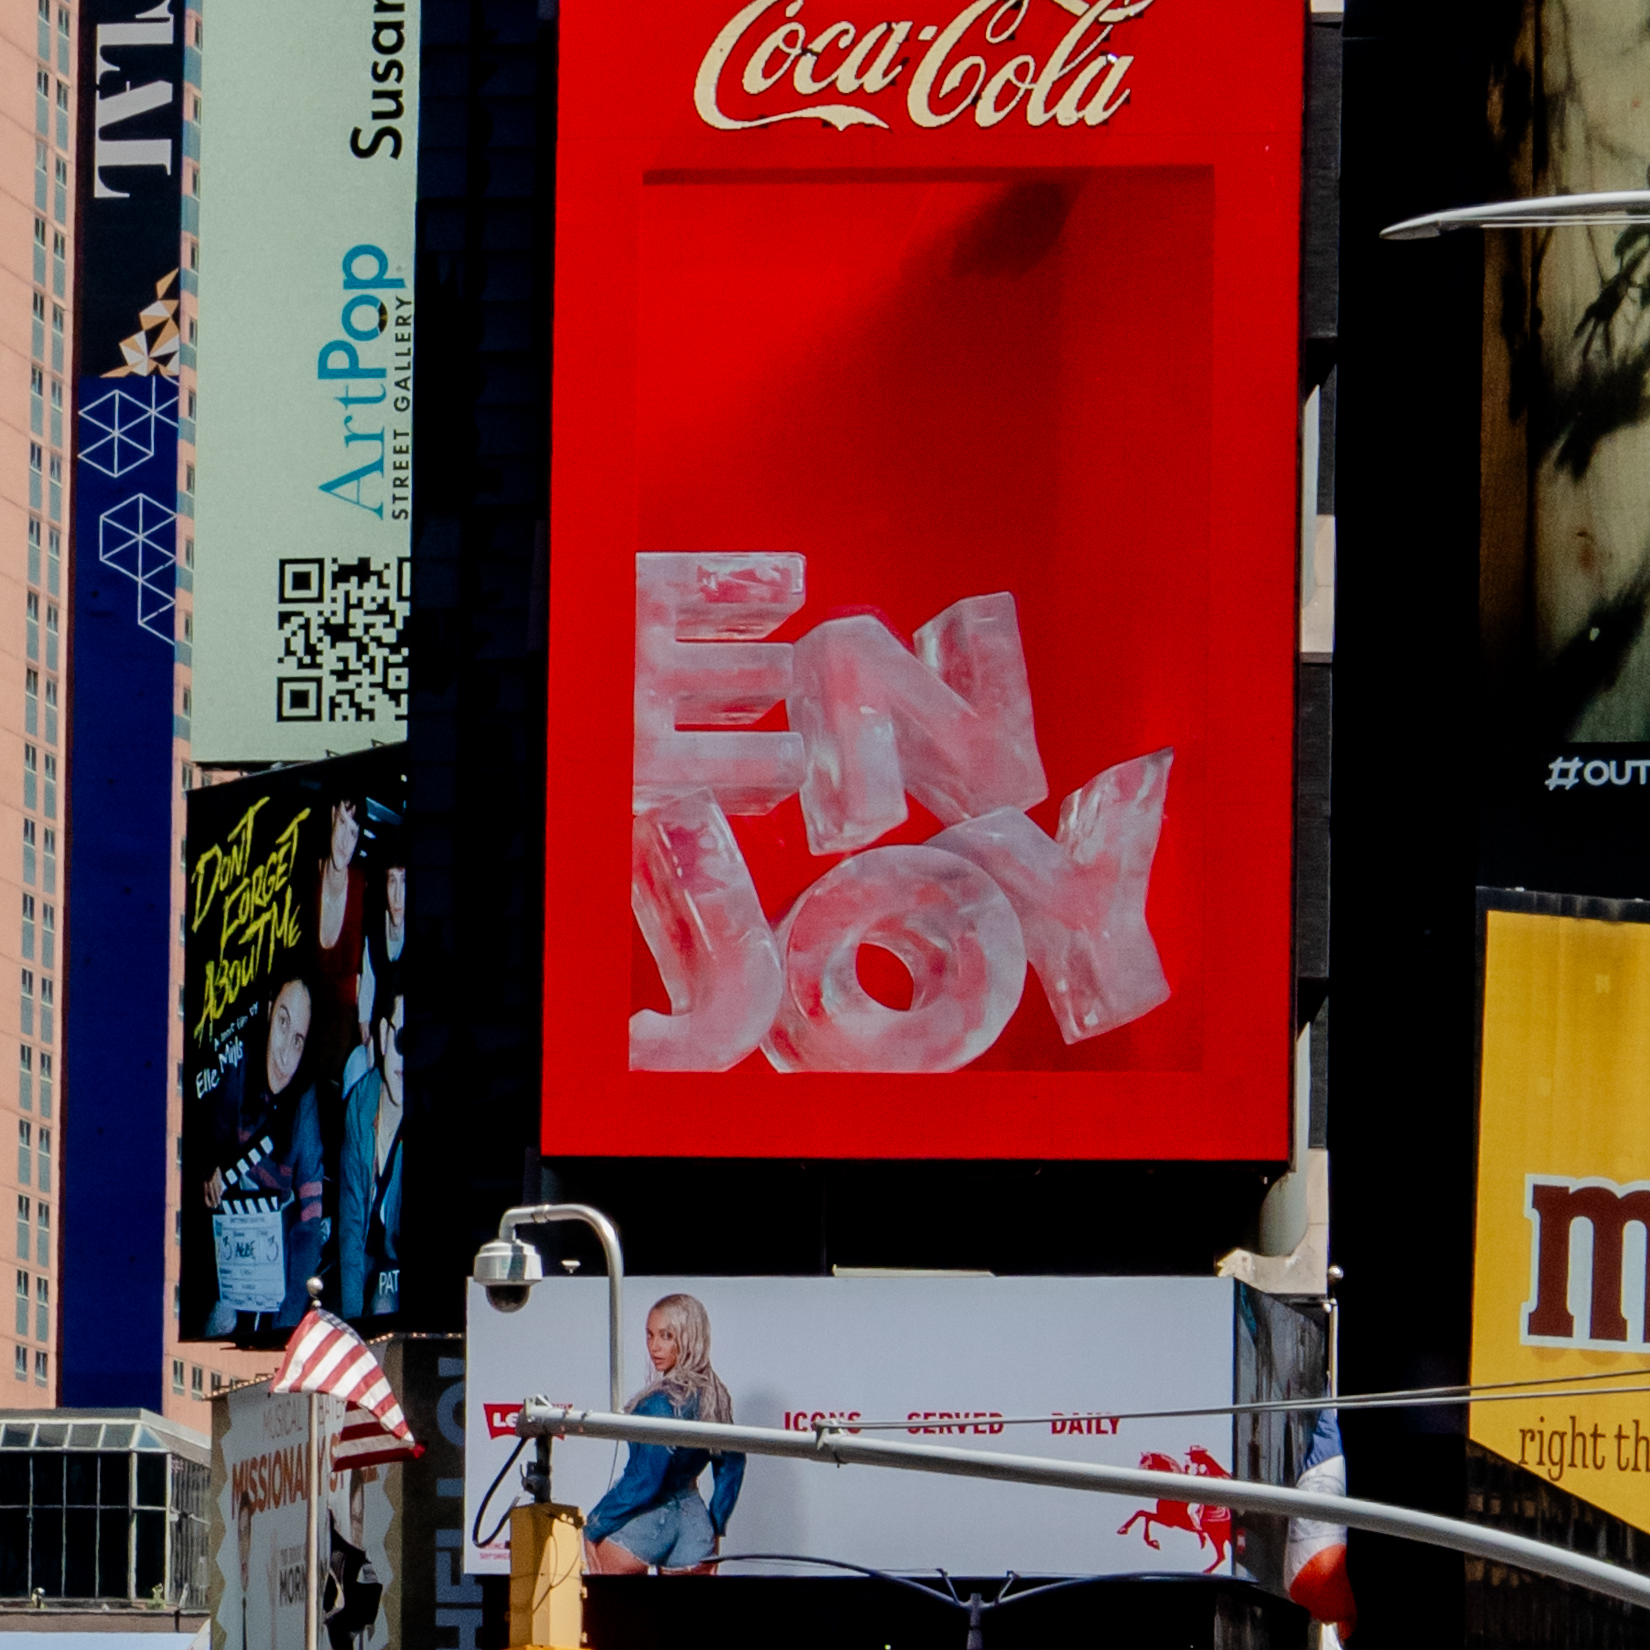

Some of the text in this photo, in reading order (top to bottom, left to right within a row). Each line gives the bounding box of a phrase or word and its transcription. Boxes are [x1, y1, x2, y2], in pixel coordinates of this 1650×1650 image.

[693, 0, 1152, 132] Coca-Cola
[317, 244, 406, 521] ArtPop
[392, 296, 412, 521] STREET GALLERY
[907, 1412, 1004, 1434] SERVED
[1051, 1412, 1120, 1435] DAILY
[1517, 1416, 1605, 1482] right
